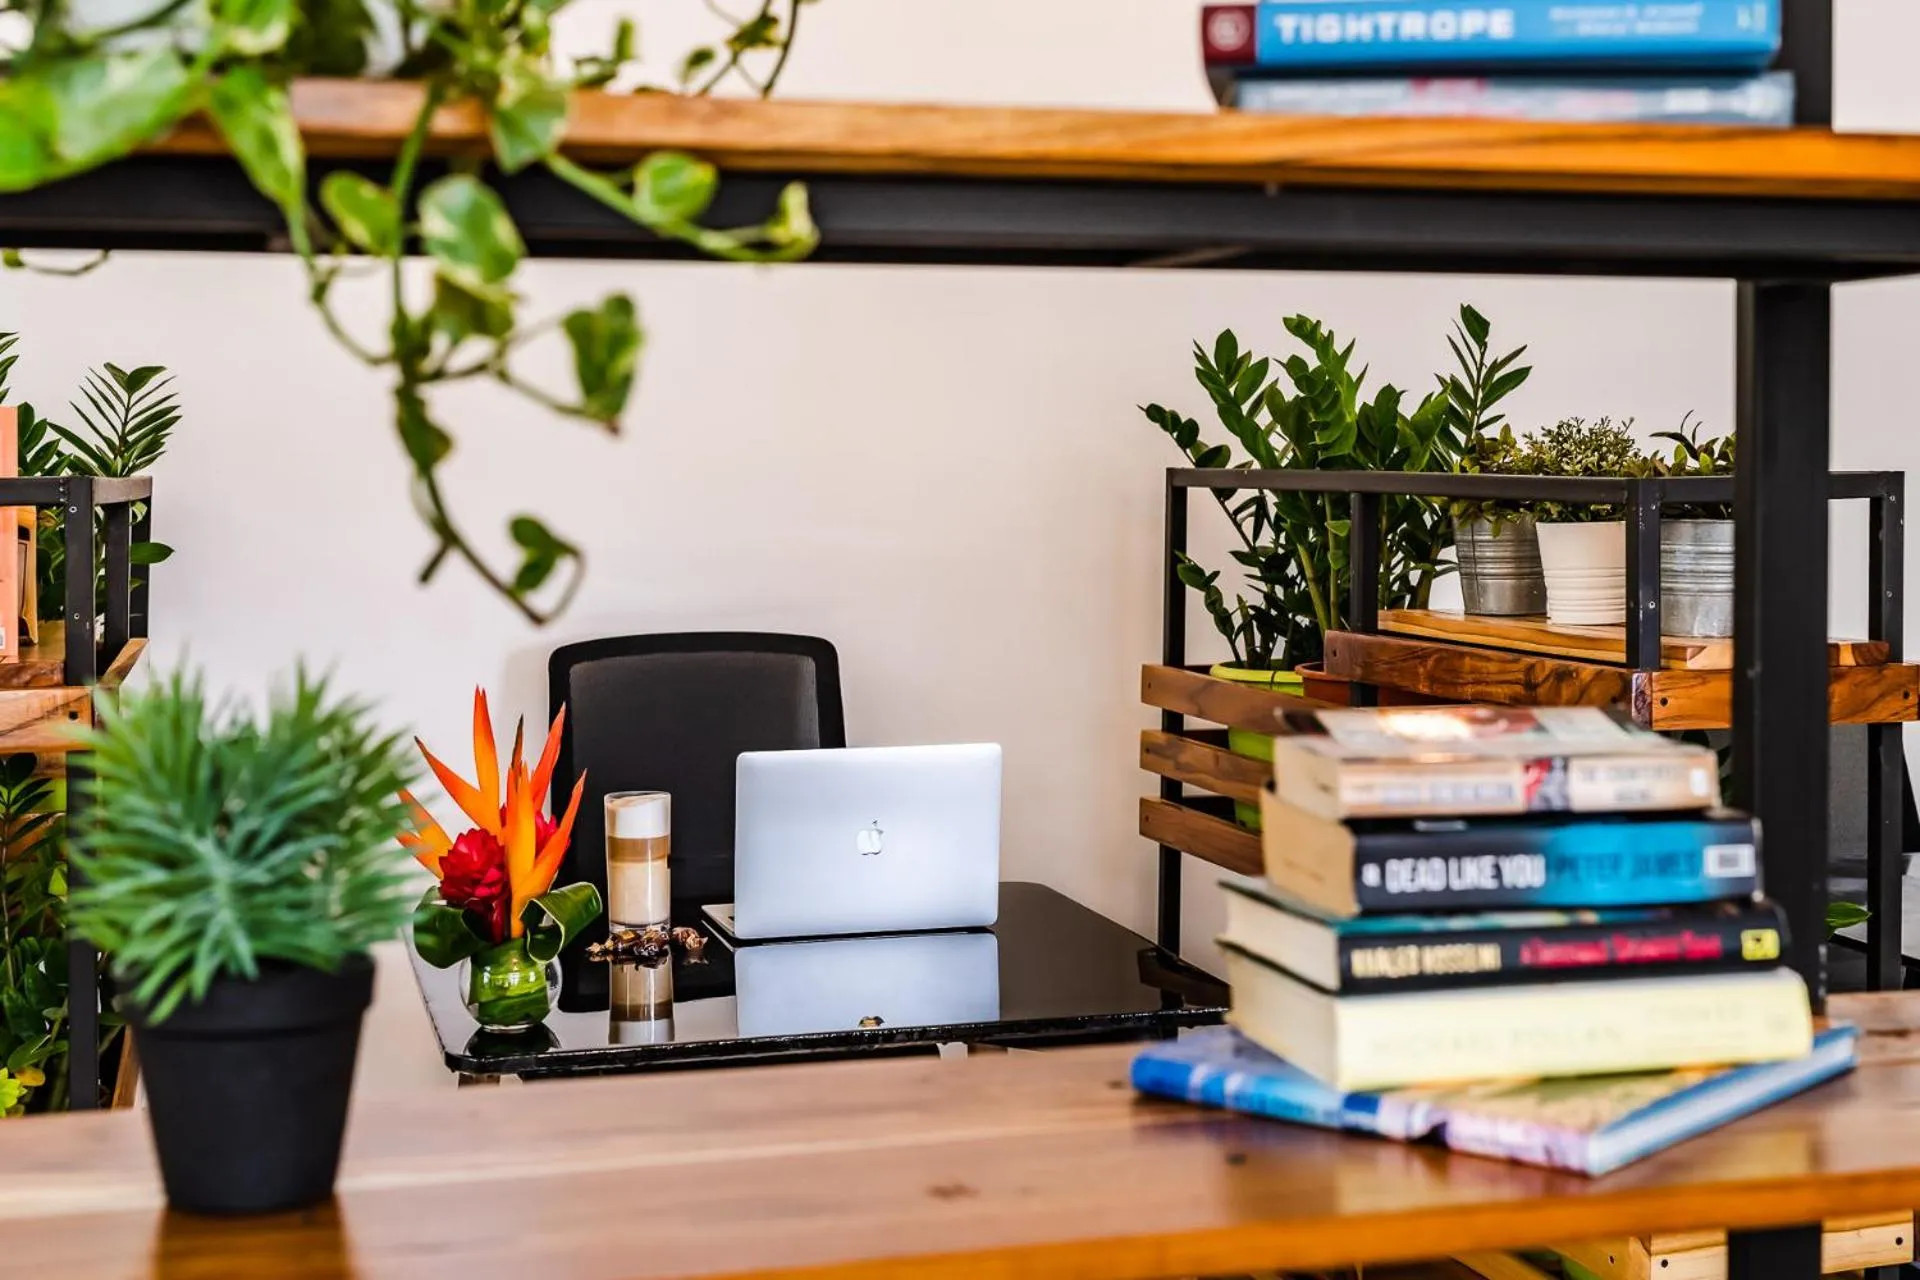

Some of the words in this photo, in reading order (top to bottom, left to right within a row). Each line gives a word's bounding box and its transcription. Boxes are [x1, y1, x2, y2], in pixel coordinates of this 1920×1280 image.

[1273, 8, 1515, 45] TIGHTROPE
[1385, 857, 1447, 894] DEAD
[1448, 855, 1499, 891] LIKE
[1499, 854, 1546, 889] YOU
